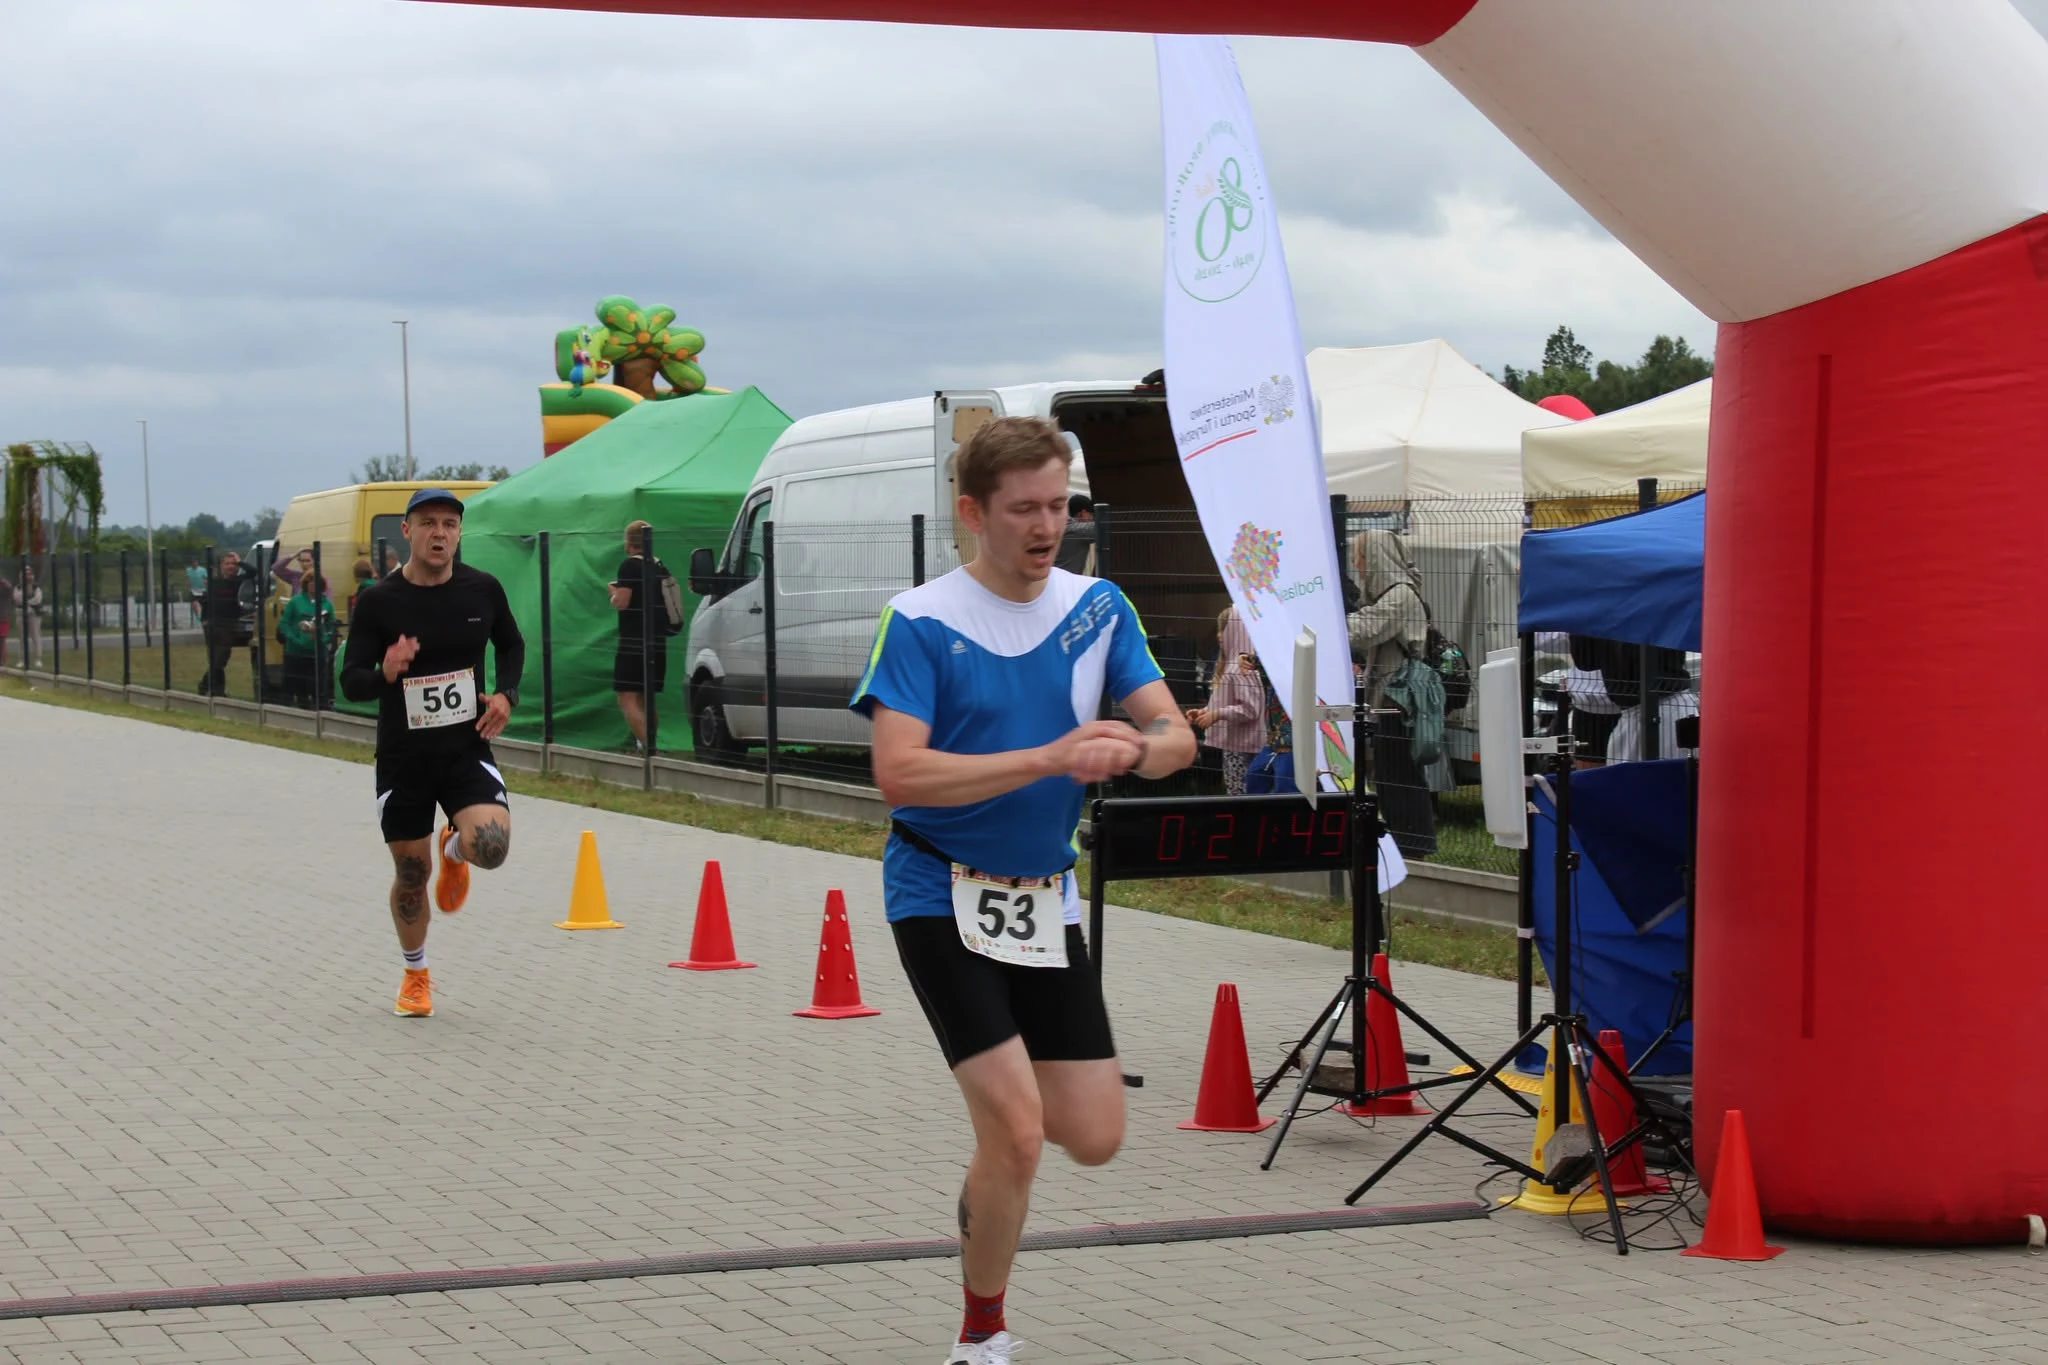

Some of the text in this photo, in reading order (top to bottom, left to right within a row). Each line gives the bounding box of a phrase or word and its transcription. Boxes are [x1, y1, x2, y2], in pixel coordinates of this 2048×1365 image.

[423, 682, 461, 713] 56
[1157, 811, 1346, 861] 0:21:49
[978, 889, 1035, 940] 53
